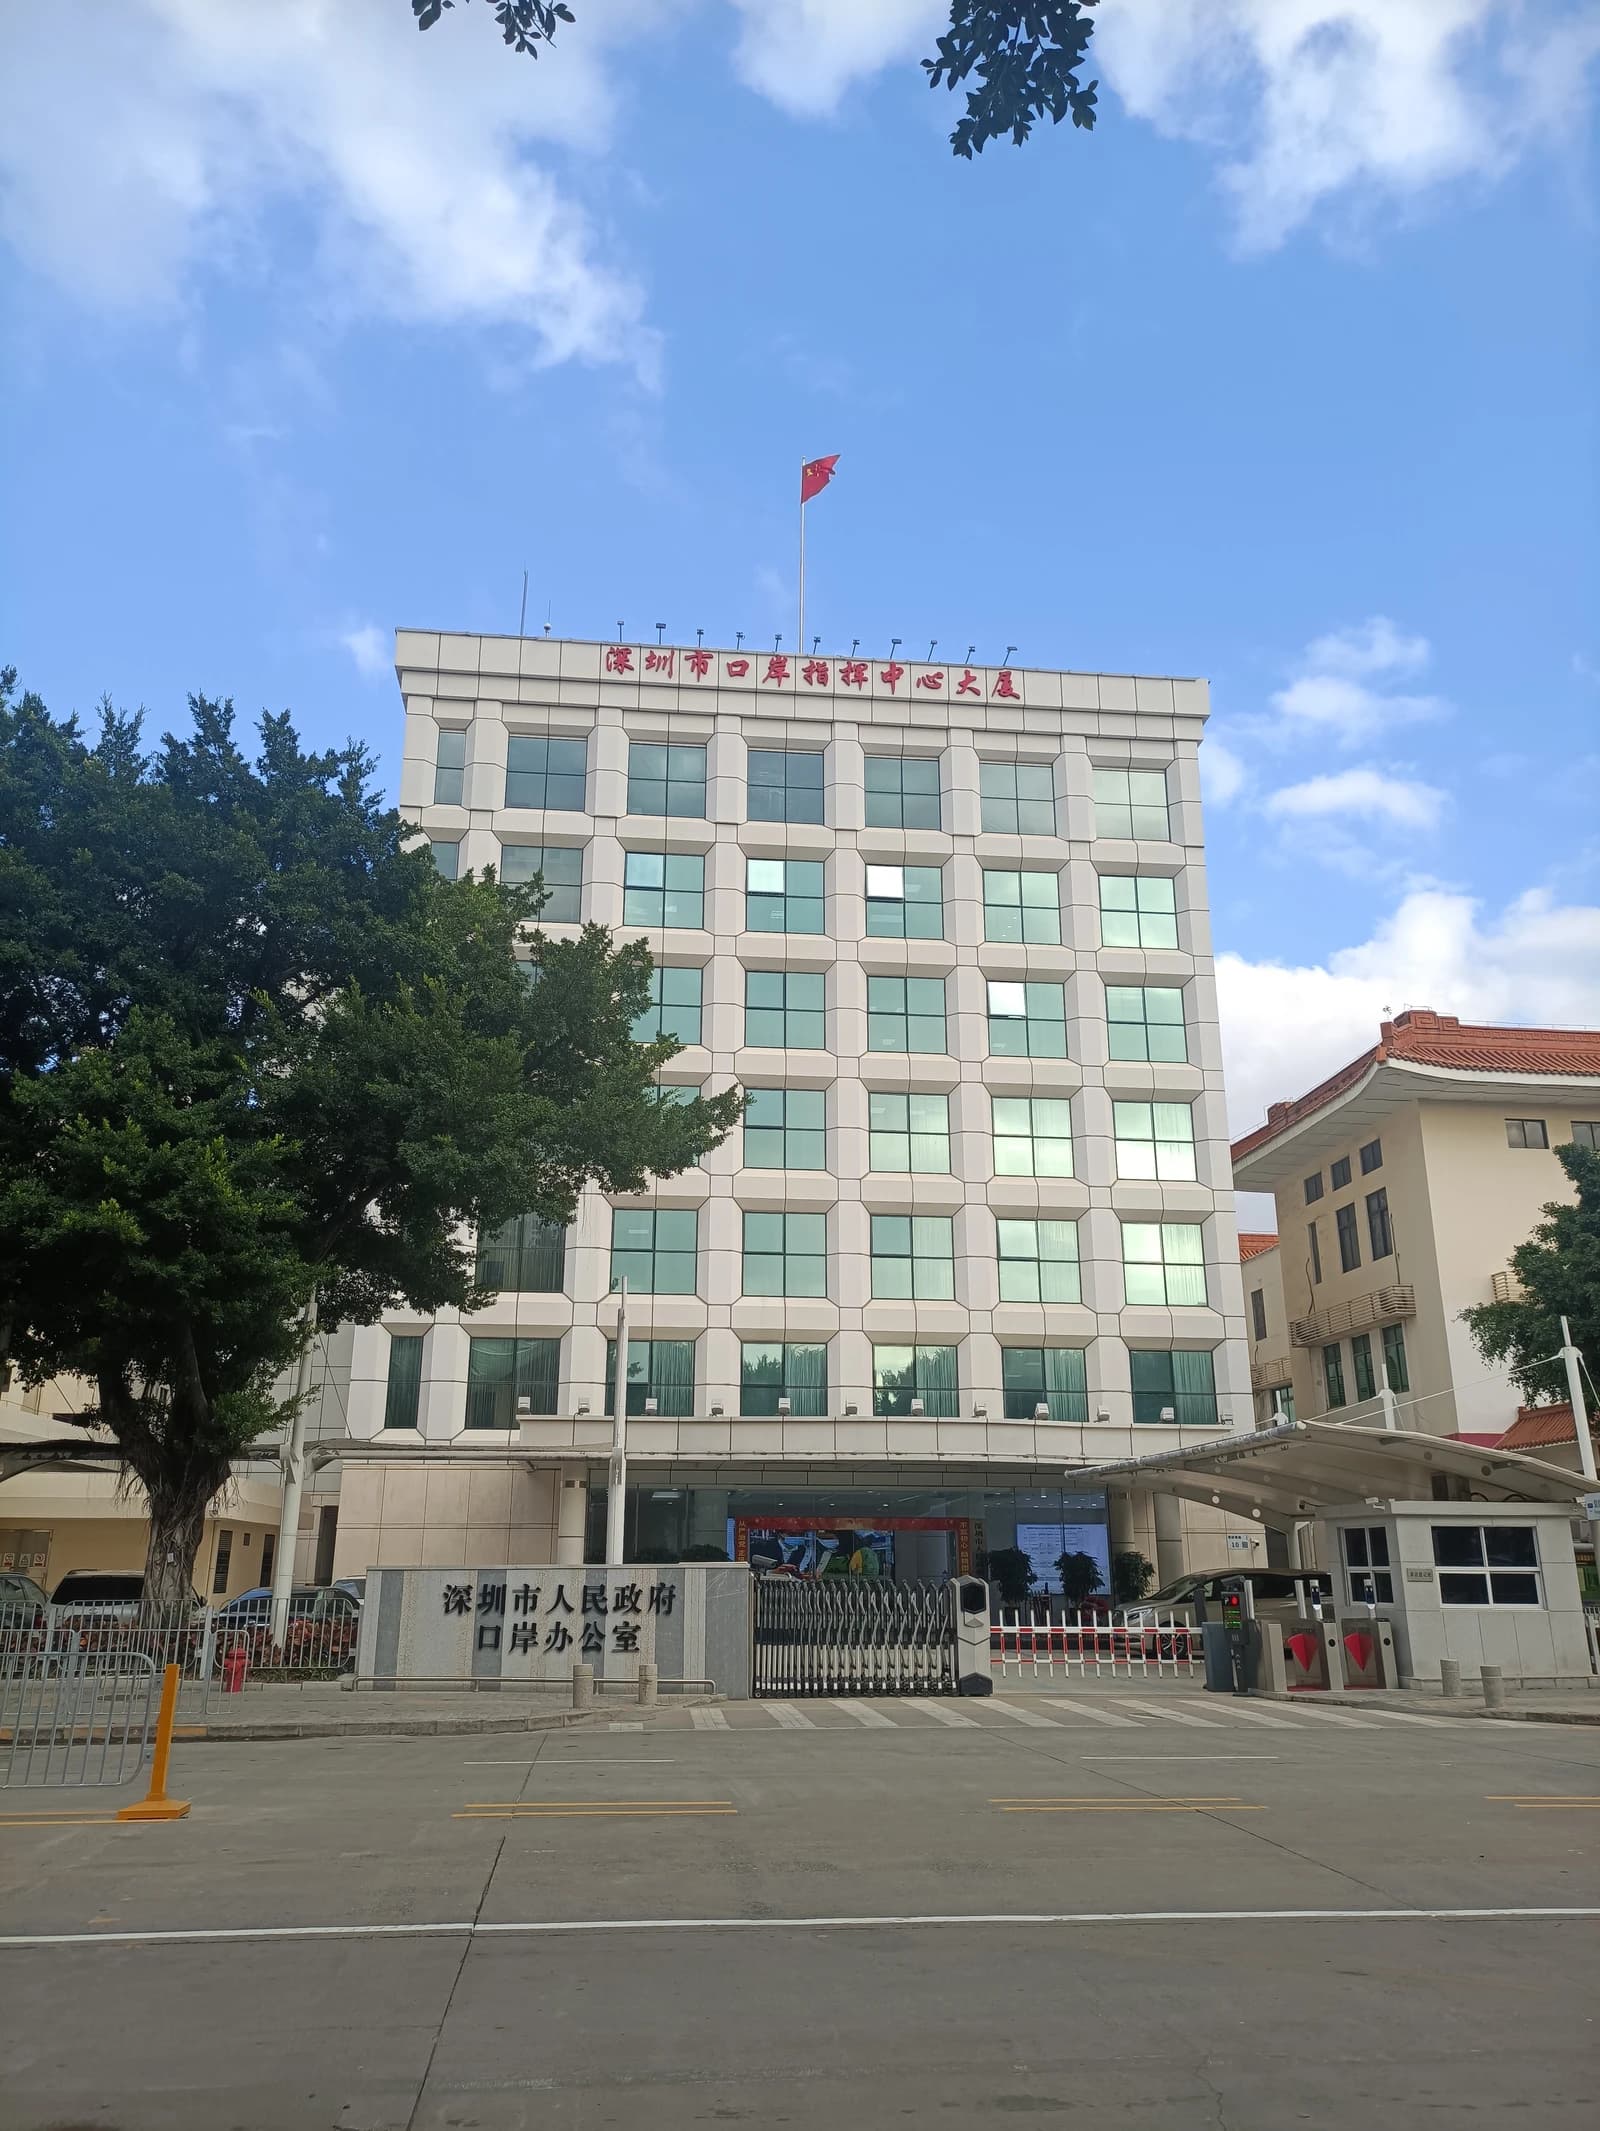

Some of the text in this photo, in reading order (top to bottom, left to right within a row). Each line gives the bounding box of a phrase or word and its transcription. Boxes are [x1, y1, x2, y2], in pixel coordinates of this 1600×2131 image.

[605, 646, 1021, 700] 深圳市口岸指挥中心大厦
[443, 1583, 676, 1615] 深圳市人民政府
[477, 1621, 642, 1655] 口岸办公室
